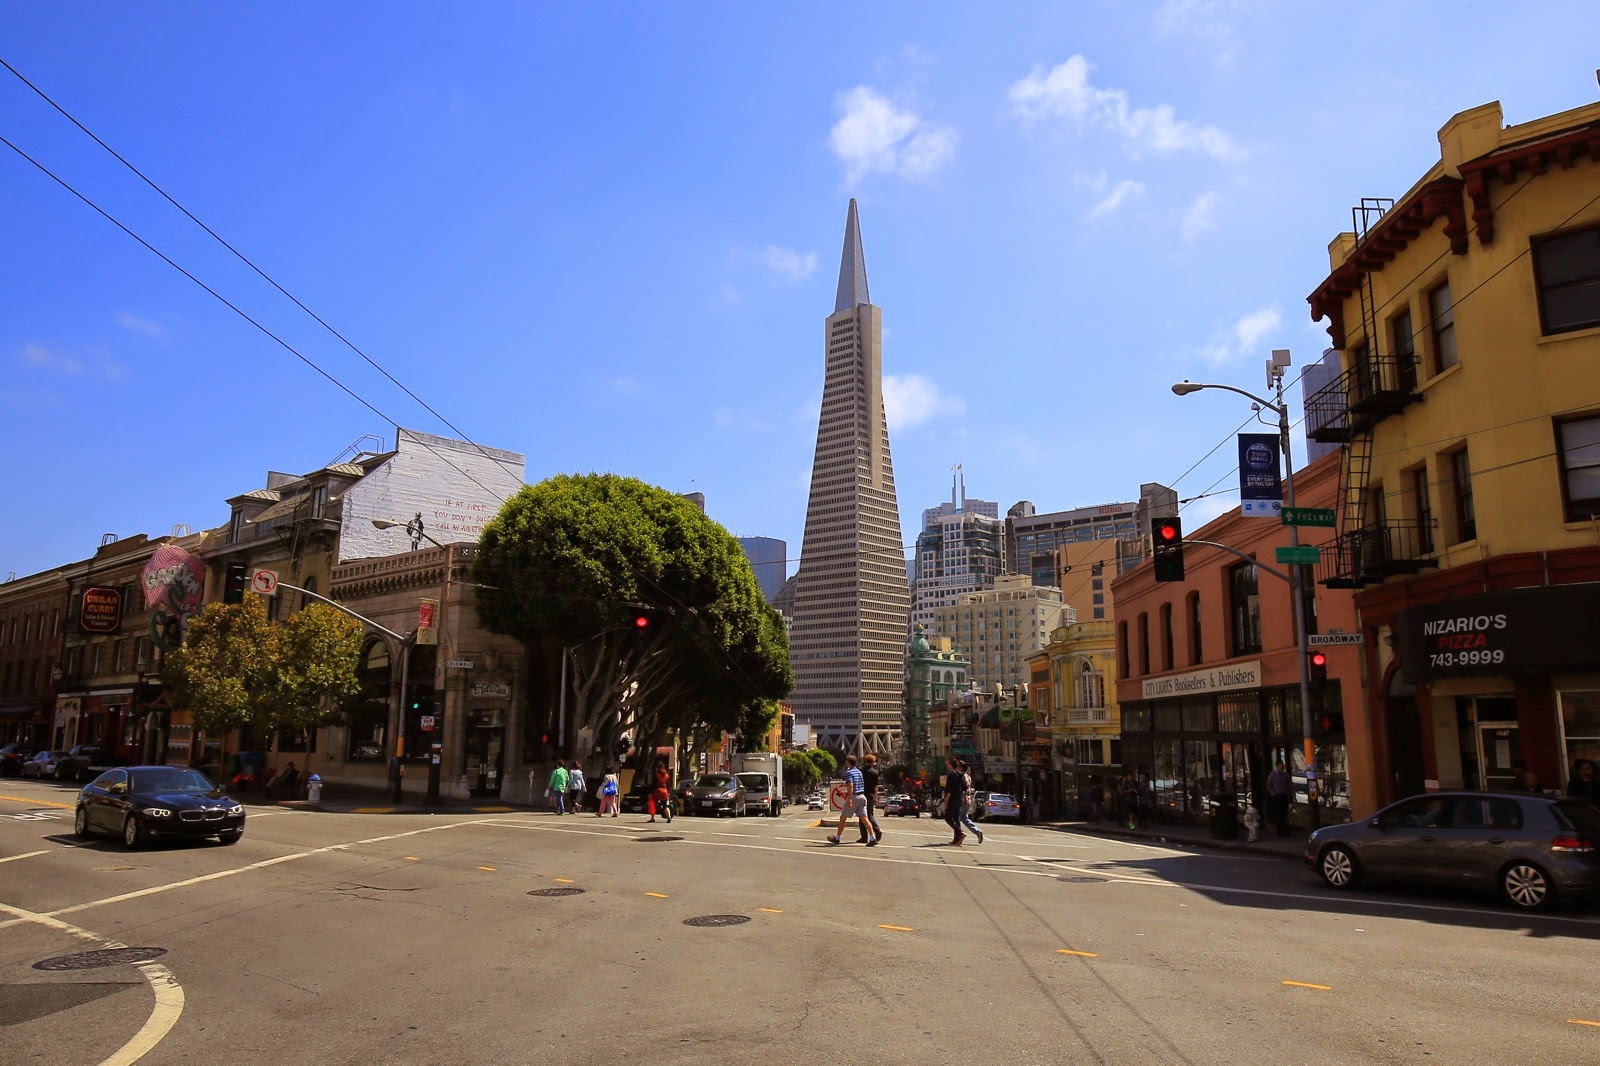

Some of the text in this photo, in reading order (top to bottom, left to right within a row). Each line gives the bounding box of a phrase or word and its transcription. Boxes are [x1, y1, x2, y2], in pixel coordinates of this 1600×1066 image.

[445, 499, 452, 507] IF
[467, 503, 486, 511] FIRST
[1099, 506, 1122, 514] Hilton
[433, 510, 448, 519] YOU
[451, 513, 472, 522] DON'T
[86, 595, 118, 603] URBAN
[88, 604, 116, 613] CURRY
[1424, 613, 1507, 636] NIZARIO'S
[1311, 635, 1361, 643] BROADWAY
[1438, 632, 1488, 650] PIZZA
[1429, 650, 1505, 667] 743-9999
[1174, 676, 1206, 692] Booksellers
[1210, 673, 1216, 688] &
[1218, 668, 1255, 686] Publishers
